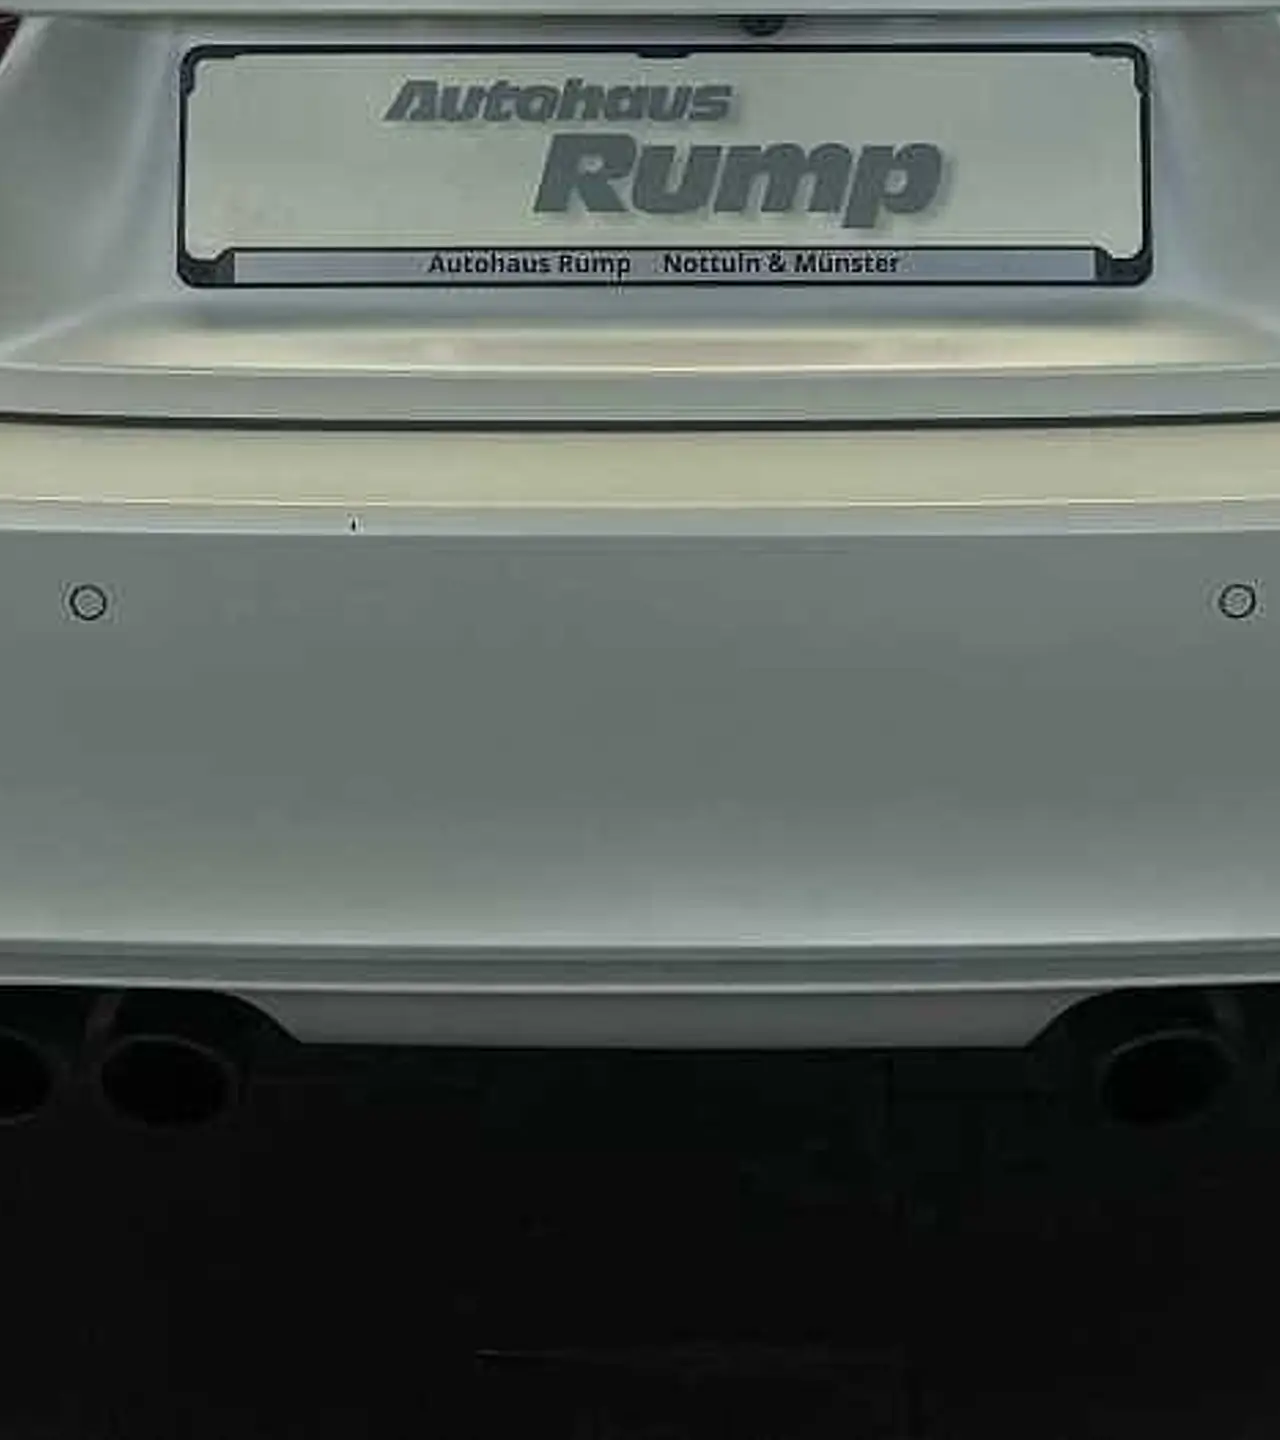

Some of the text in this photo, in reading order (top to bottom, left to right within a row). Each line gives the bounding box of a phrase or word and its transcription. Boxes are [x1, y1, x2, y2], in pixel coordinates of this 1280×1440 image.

[383, 78, 733, 122] Autohaus
[533, 132, 943, 229] Rump
[428, 250, 898, 280] Autohaus Rump Nottuln & Münster
